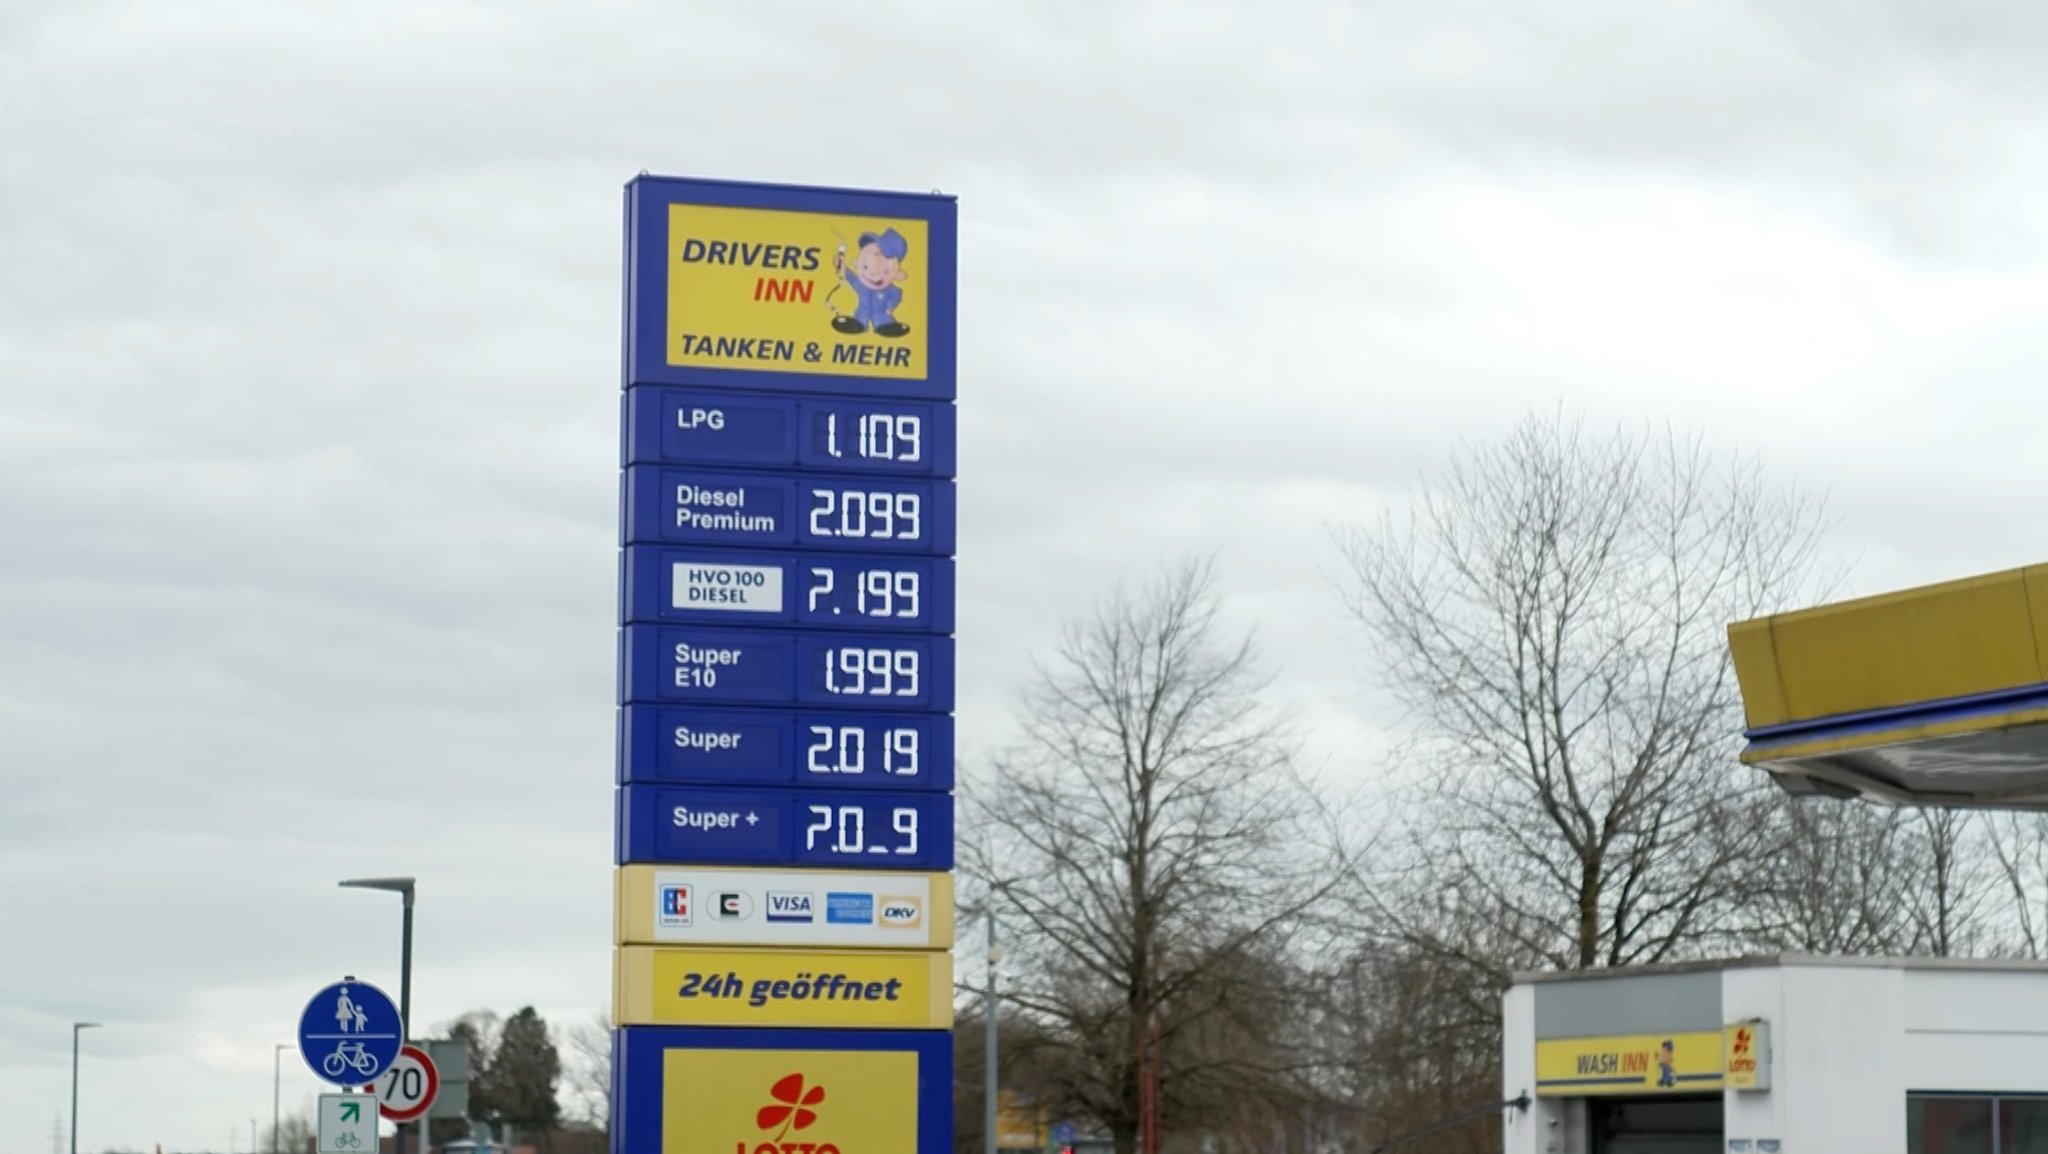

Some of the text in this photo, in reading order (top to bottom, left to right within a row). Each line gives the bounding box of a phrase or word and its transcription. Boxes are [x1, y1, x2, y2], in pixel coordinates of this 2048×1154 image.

[682, 239, 821, 271] DRIVERS
[754, 278, 814, 304] INN
[682, 335, 911, 367] TANKEN & MEHR
[677, 408, 725, 430] LPG
[676, 485, 744, 507] Diesel
[676, 508, 775, 533] Premium
[810, 489, 920, 540] 2.099
[688, 569, 765, 587] HVO 100
[688, 587, 747, 604] DIESEL
[674, 644, 742, 668] Super
[674, 667, 716, 688] E10
[825, 647, 919, 697] 1.999
[674, 727, 742, 752] Super
[673, 807, 740, 831] Super
[772, 896, 811, 912] VISA
[678, 972, 902, 1007] 24h geöffnet
[1577, 1051, 1650, 1075] WASH INN
[384, 1067, 421, 1101] 70
